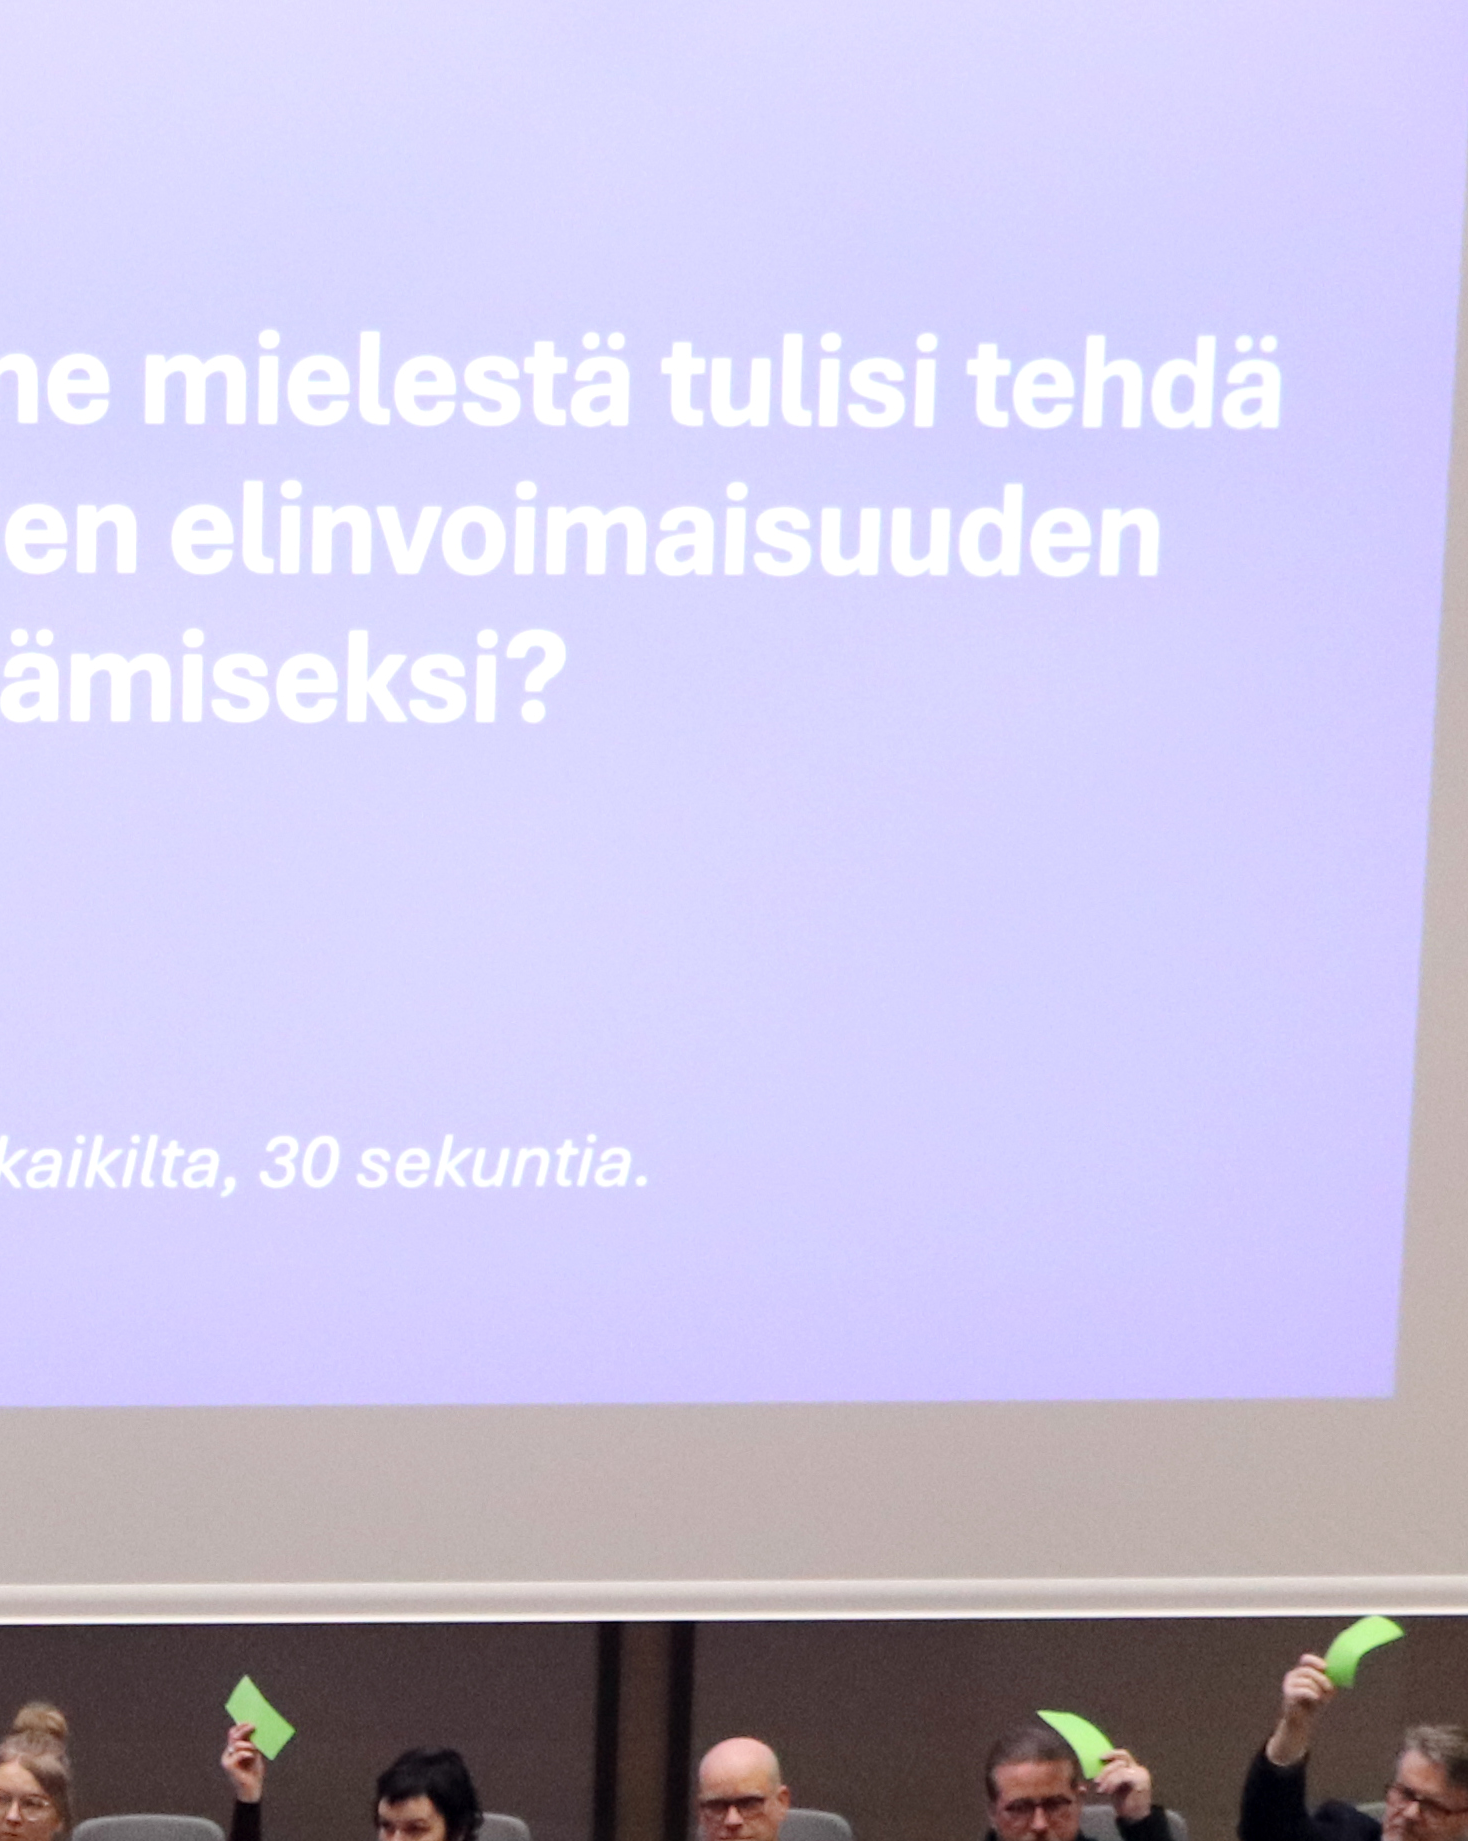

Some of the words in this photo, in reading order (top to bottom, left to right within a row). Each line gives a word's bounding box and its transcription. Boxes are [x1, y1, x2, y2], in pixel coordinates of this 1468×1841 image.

[144, 328, 631, 428] mielestä
[660, 331, 938, 428] tulisi
[966, 334, 1282, 430] tehdä
[170, 479, 1160, 578] elinvoimaisuuden
[259, 1134, 341, 1189] 30
[355, 1133, 648, 1189] sekuntia.
